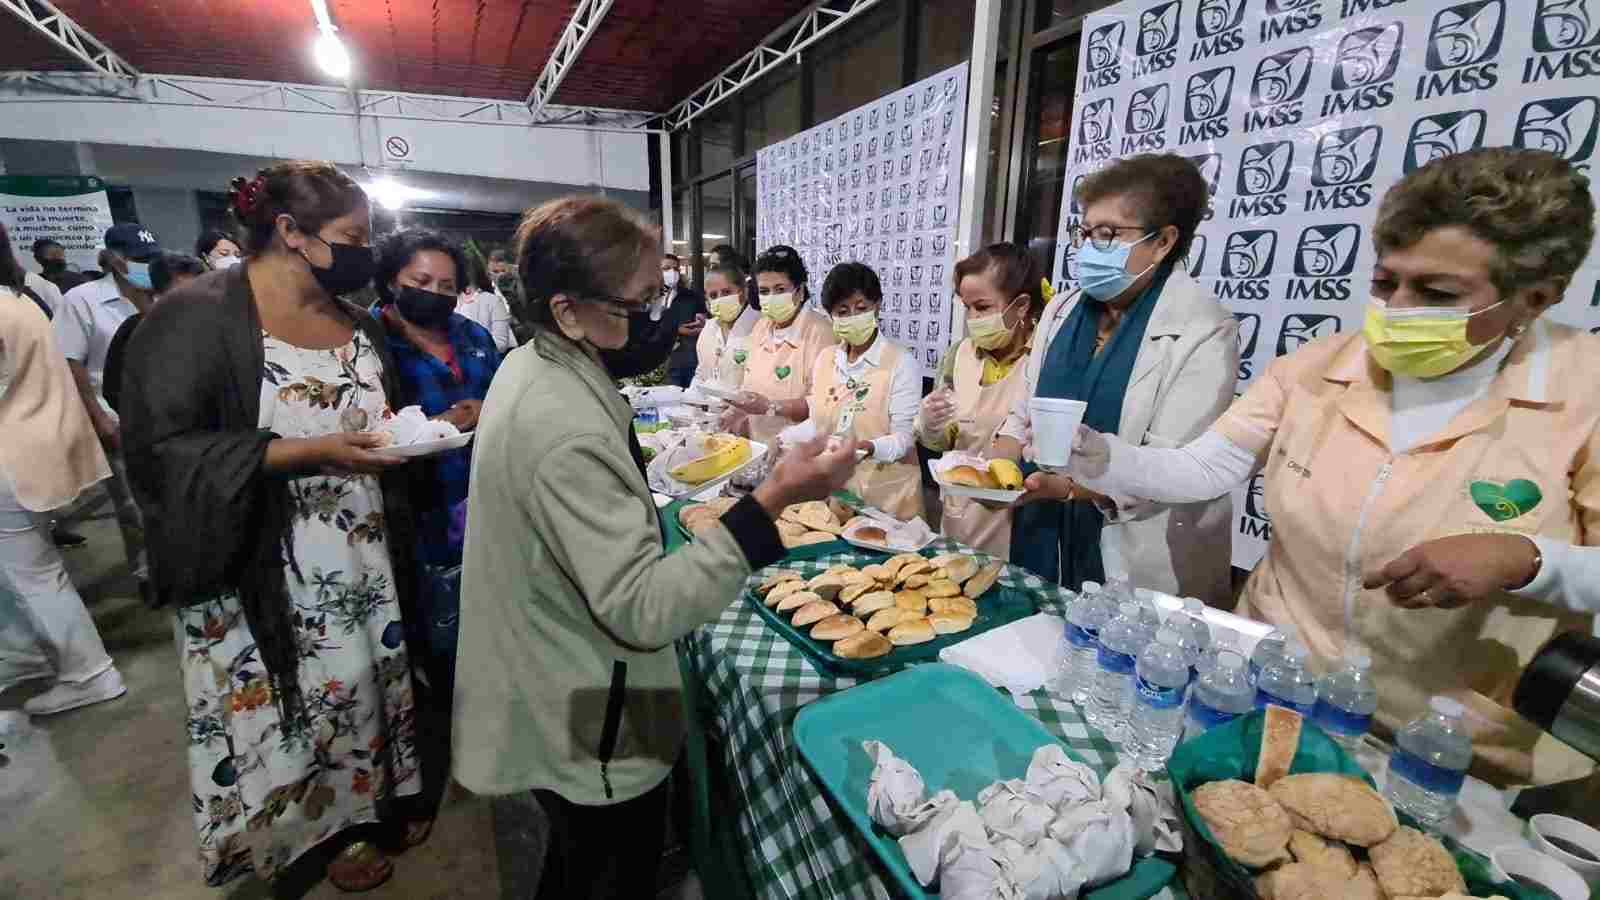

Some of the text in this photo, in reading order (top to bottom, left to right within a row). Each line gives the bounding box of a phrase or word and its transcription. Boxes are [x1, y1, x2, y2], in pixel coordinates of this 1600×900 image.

[1260, 3, 1322, 42] IMSS
[1340, 0, 1405, 18] IM
[1190, 28, 1244, 62] IMSS
[1132, 48, 1176, 79] IMSS
[1082, 66, 1121, 93] IMSS
[1415, 63, 1499, 100] IMSS
[1320, 82, 1394, 117] IMSS
[1178, 116, 1229, 146] IMSS
[1243, 101, 1304, 133] IMSS
[1074, 141, 1112, 164] IMSS
[1120, 131, 1165, 155] IMSS
[1228, 194, 1287, 219] IMSS
[1304, 183, 1372, 212] IMSS
[1214, 279, 1270, 300] IMSS
[1285, 278, 1351, 301] IMSS
[1240, 516, 1272, 540] IM
